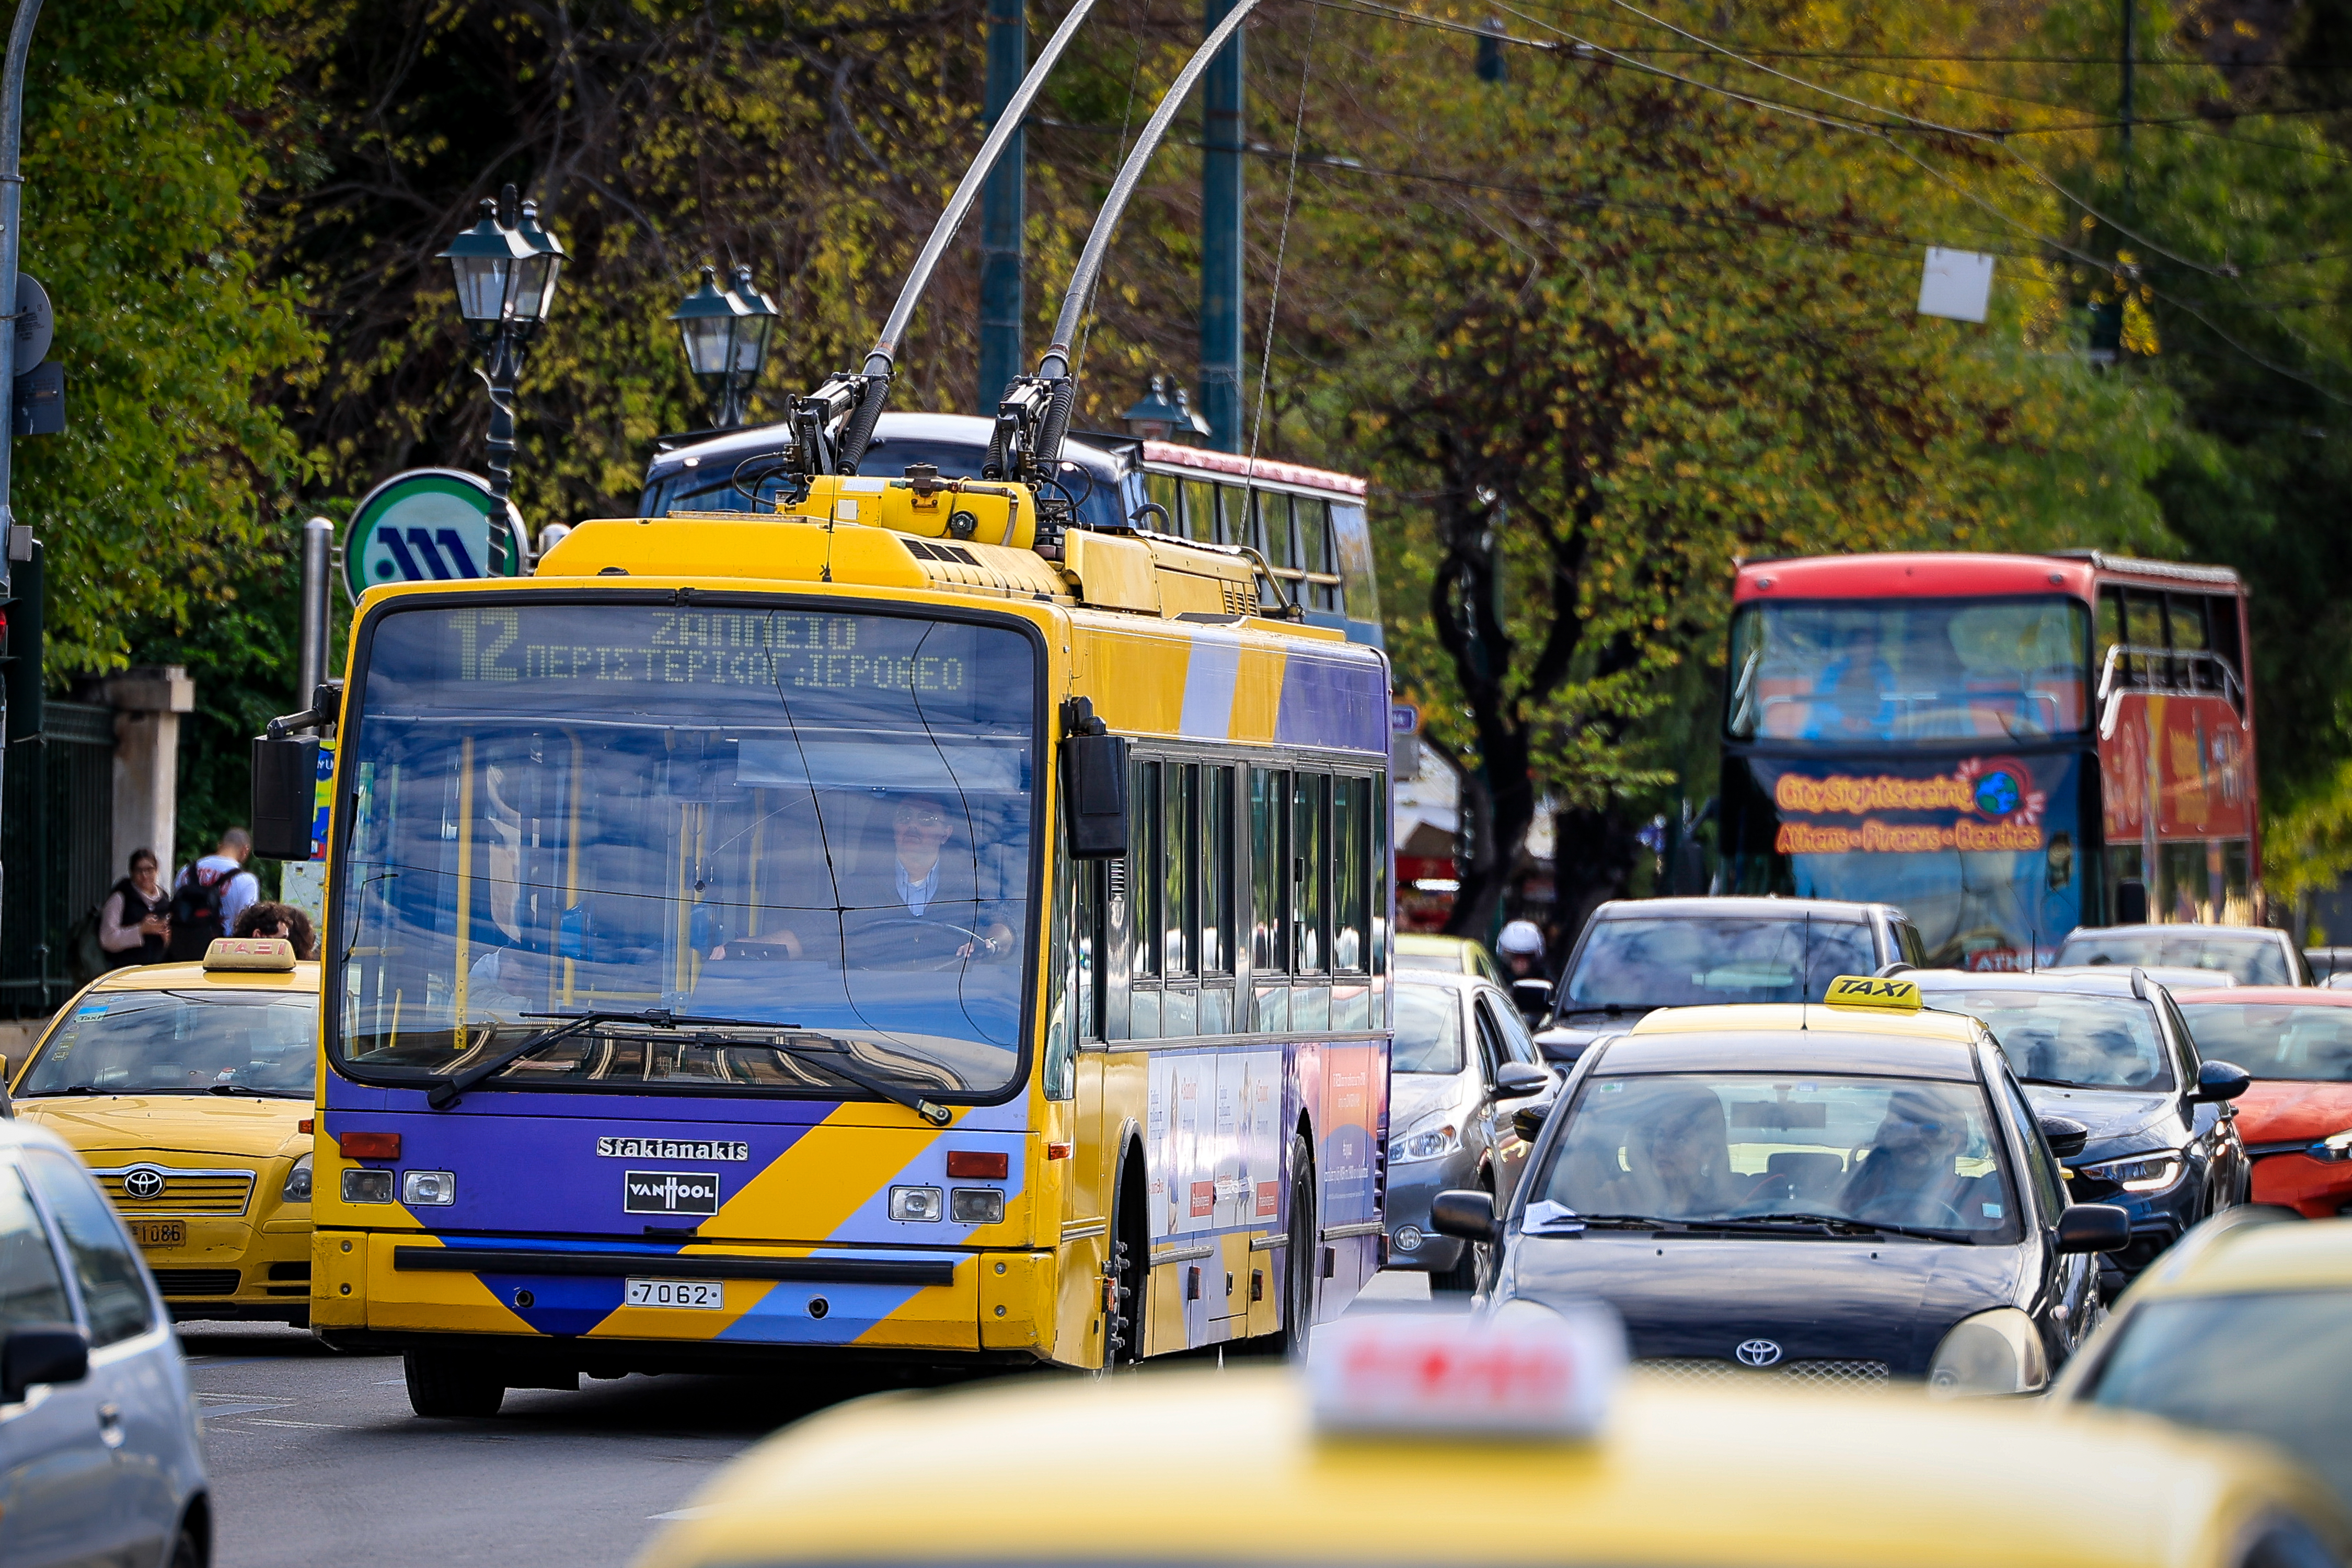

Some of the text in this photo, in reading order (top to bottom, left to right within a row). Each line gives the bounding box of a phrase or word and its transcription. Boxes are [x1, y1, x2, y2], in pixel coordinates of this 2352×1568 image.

[652, 612, 856, 650] ΖΑΠΠΕΙΟ
[449, 608, 518, 681] 12
[215, 941, 286, 955] ΤΑΞΙ
[1837, 979, 1913, 998] TAXI
[598, 1137, 747, 1160] Sfakianakis
[639, 1284, 707, 1305] 7062
